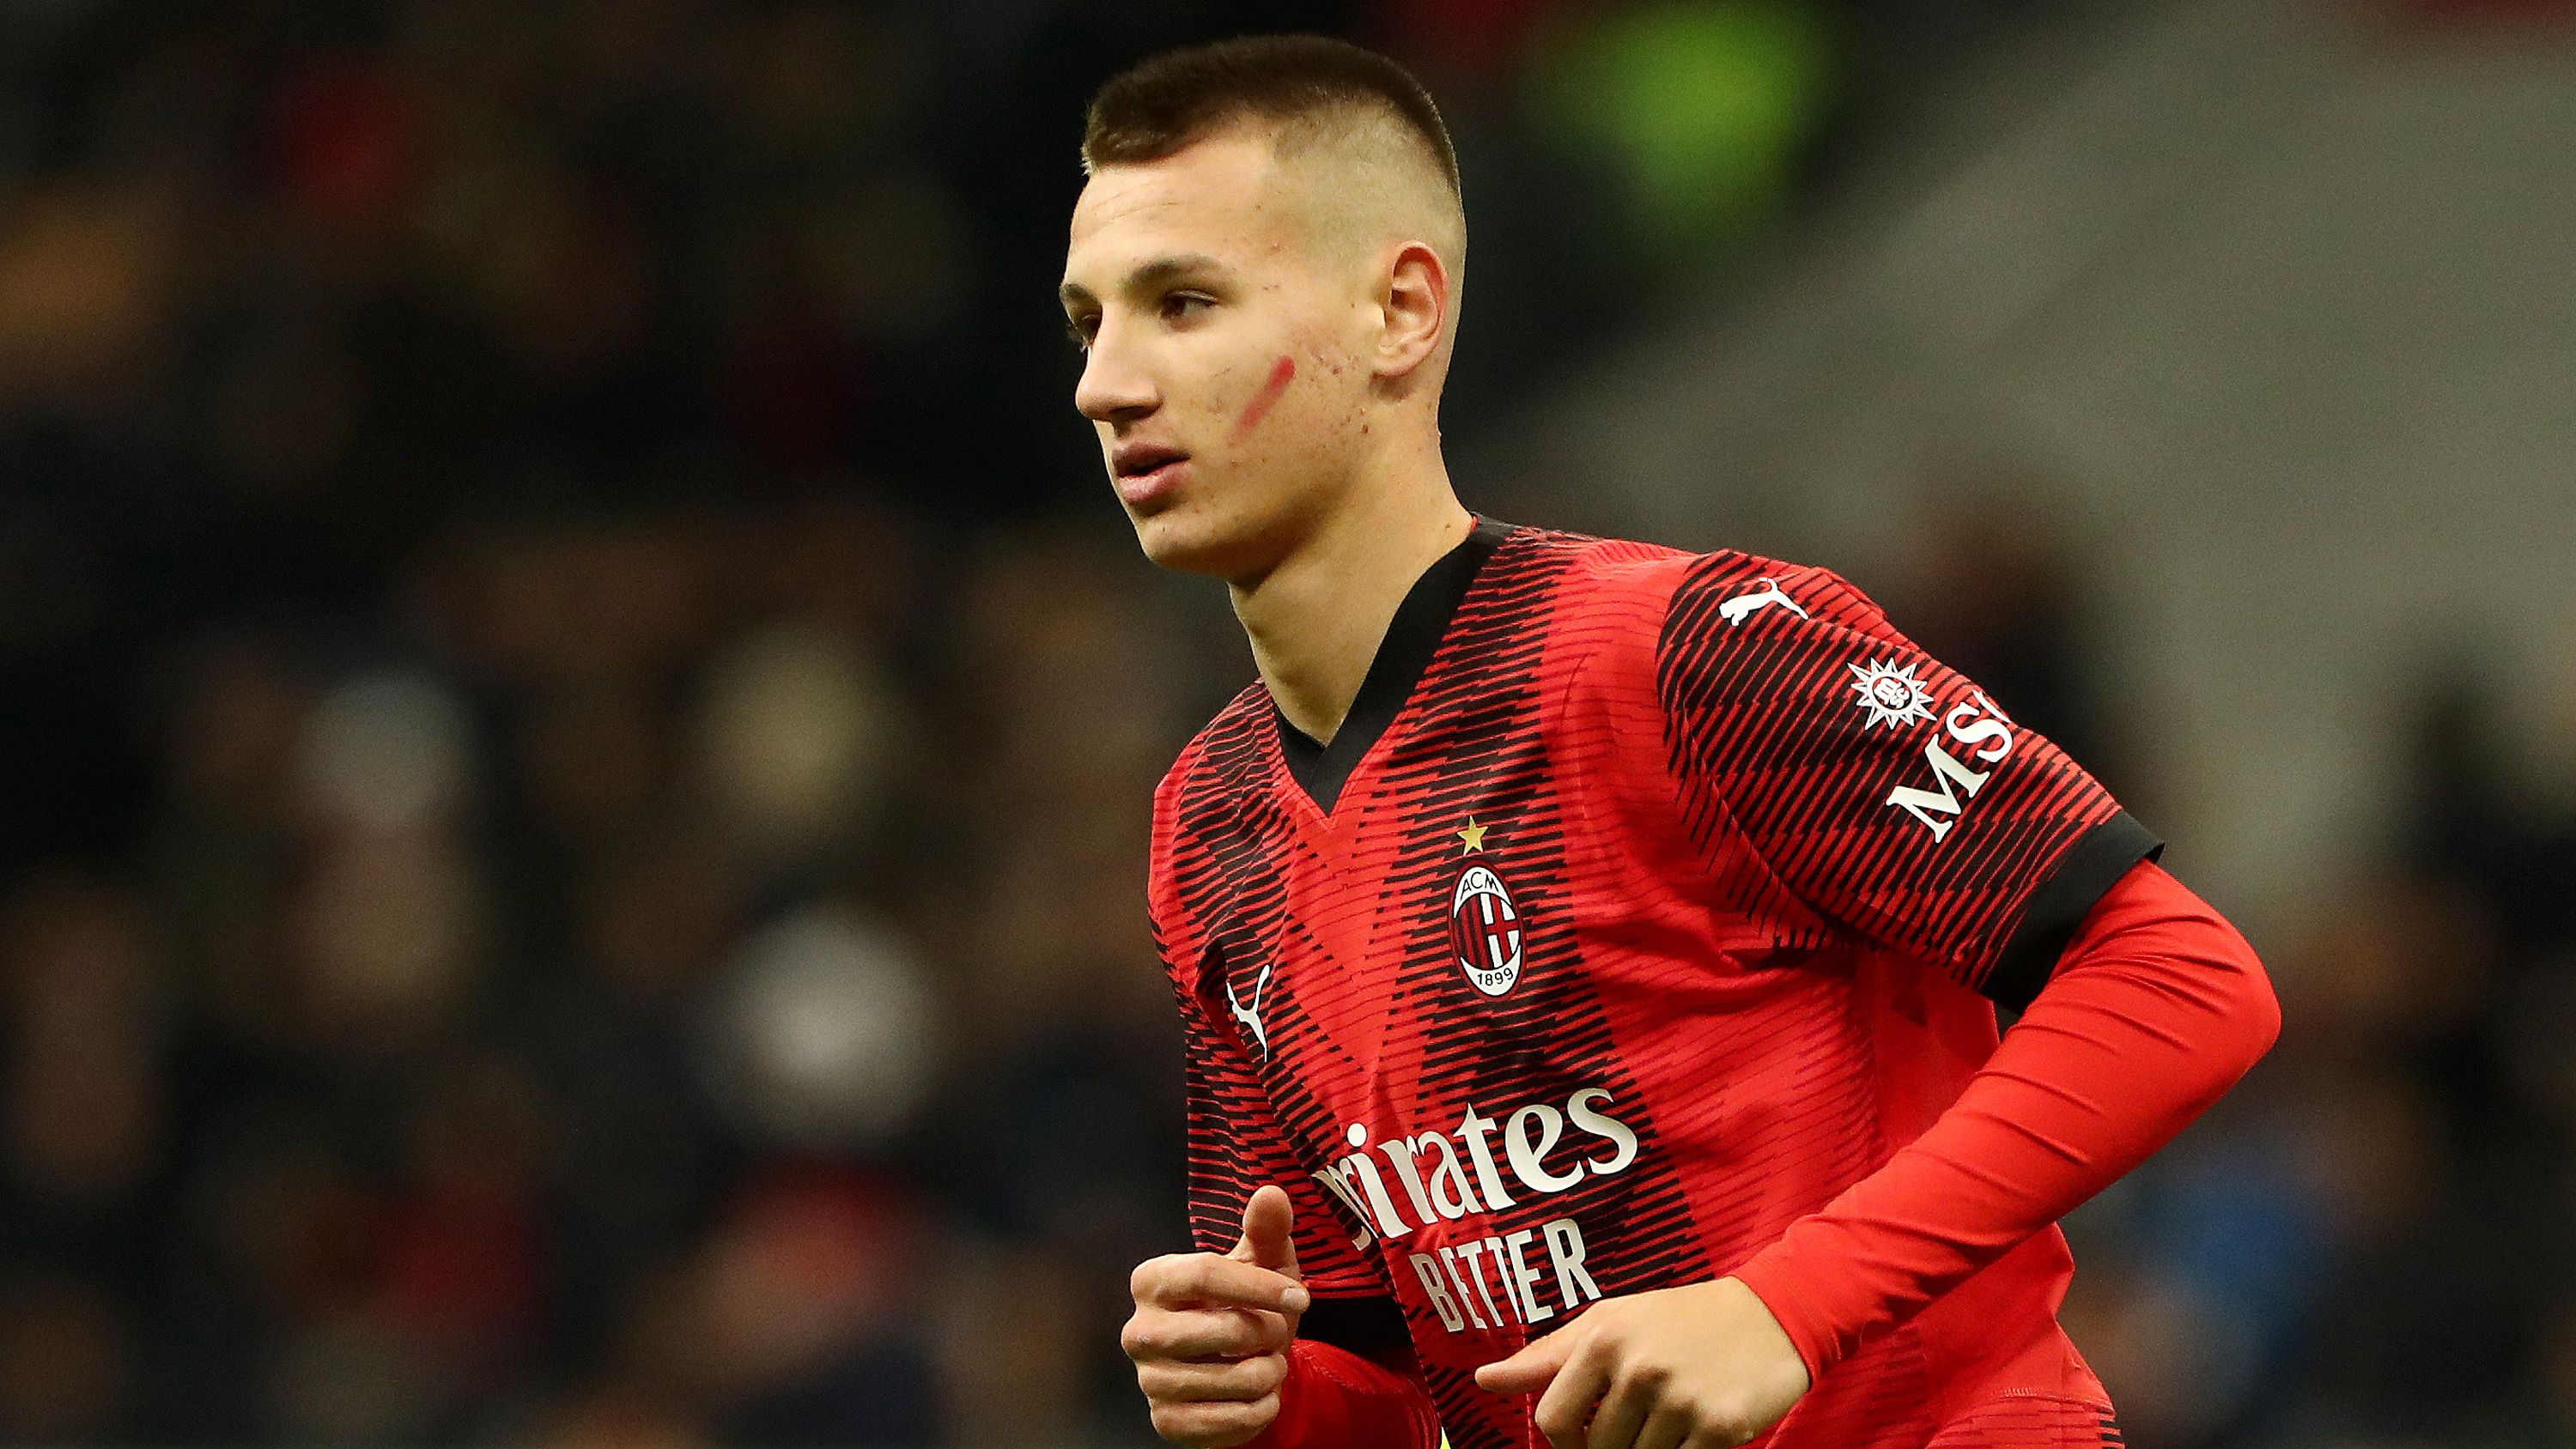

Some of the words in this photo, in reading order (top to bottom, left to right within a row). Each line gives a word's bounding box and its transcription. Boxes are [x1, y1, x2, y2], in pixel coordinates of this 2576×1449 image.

[1460, 871, 1499, 901] ACM
[1477, 967, 1514, 986] 1899
[1311, 1088, 1638, 1252] mirates
